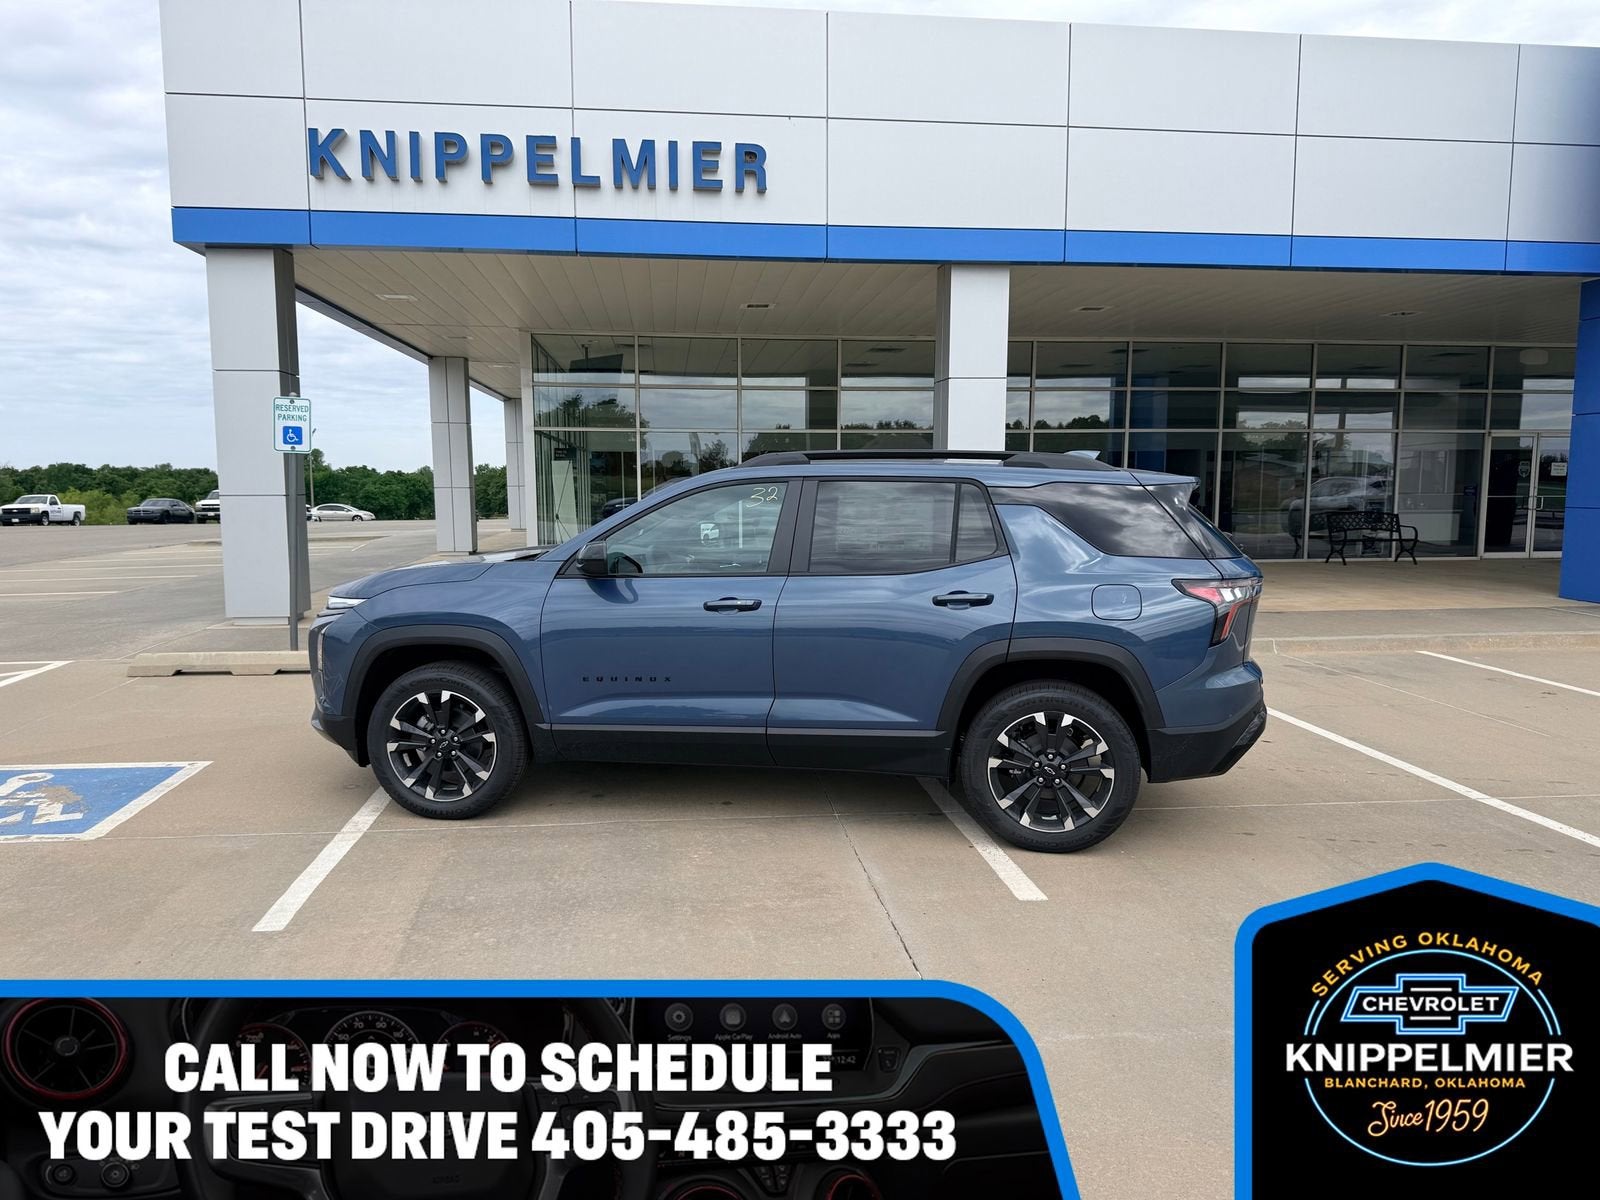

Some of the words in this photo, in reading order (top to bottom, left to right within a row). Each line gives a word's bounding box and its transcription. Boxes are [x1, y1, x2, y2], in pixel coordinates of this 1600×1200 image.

[307, 127, 769, 193] KNIPPELMIER
[275, 404, 309, 413] RESERVED
[278, 413, 307, 422] PARKING
[746, 486, 778, 508] 32
